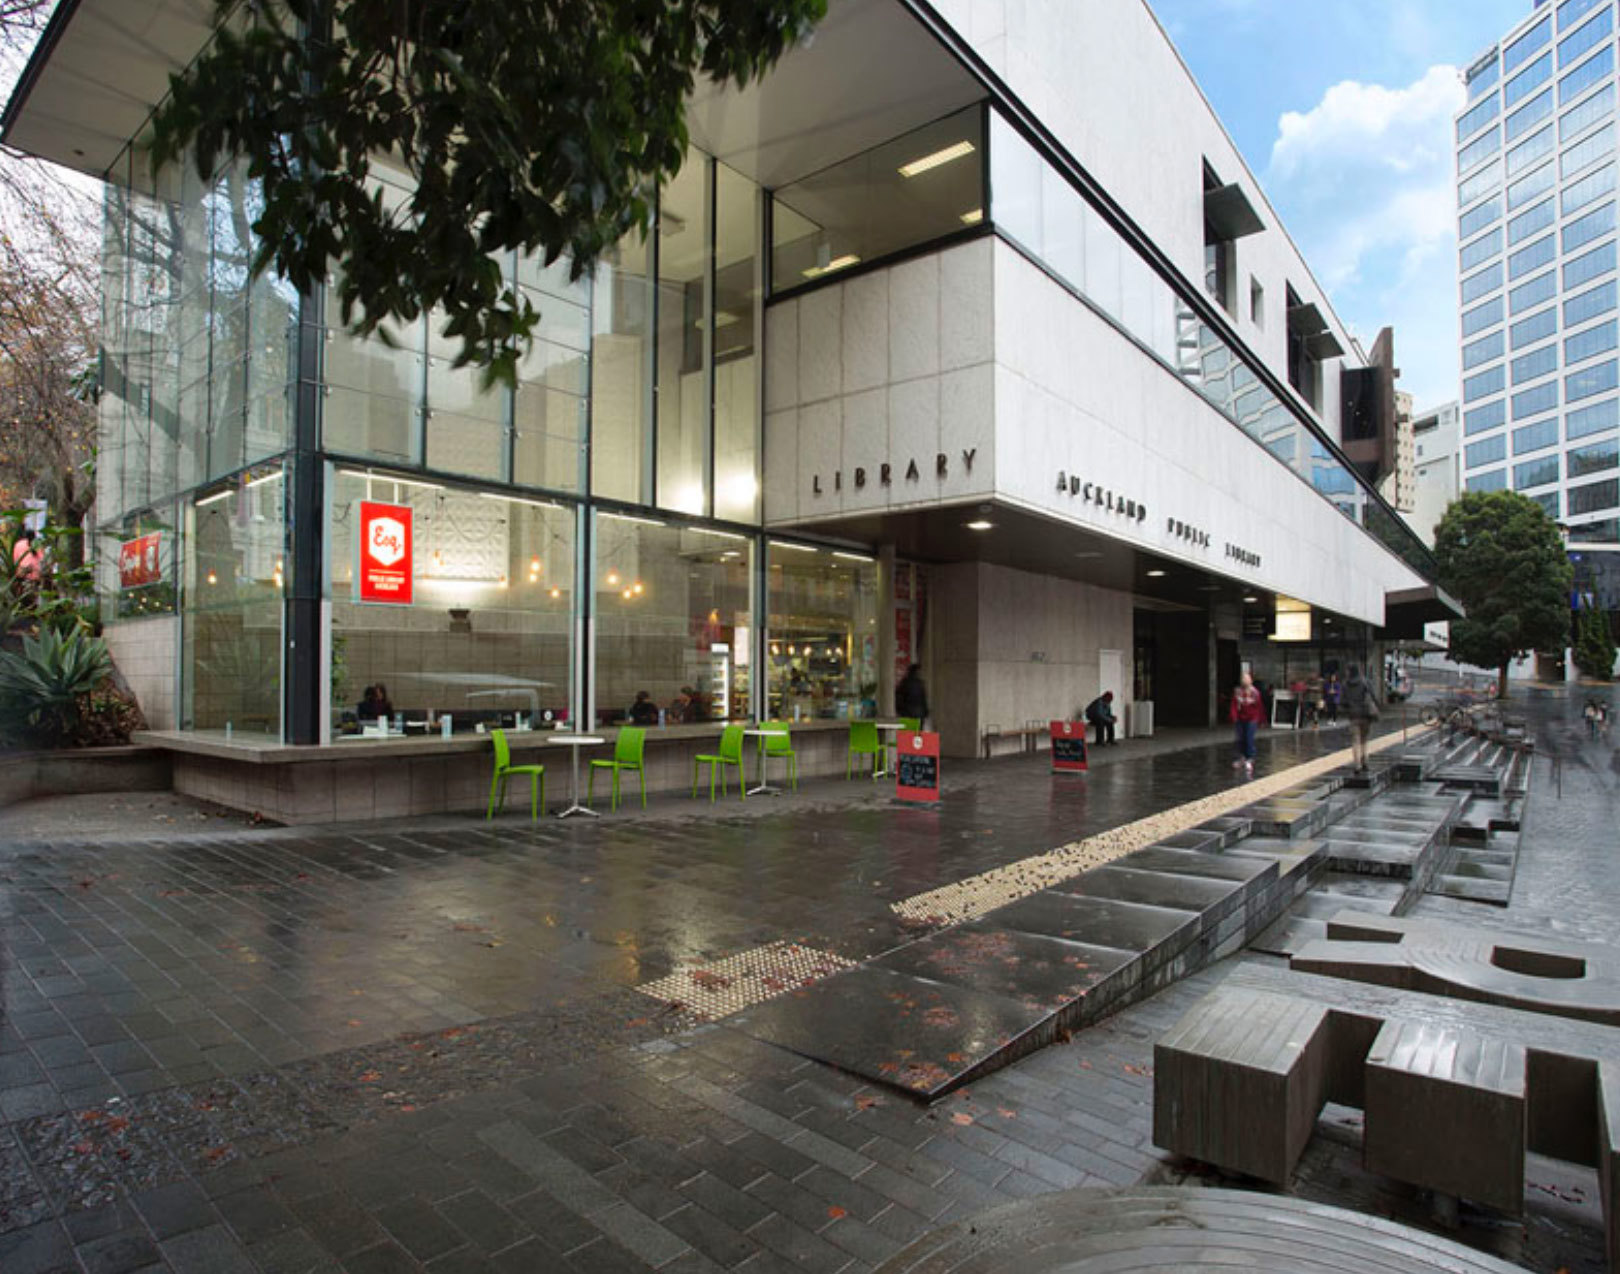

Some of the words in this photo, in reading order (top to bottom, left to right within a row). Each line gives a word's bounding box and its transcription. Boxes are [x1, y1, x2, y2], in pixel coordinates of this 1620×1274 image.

[813, 448, 977, 494] LIBRARY
[1056, 470, 1147, 522] AUCKLAND
[1167, 517, 1211, 548] PUBLIC
